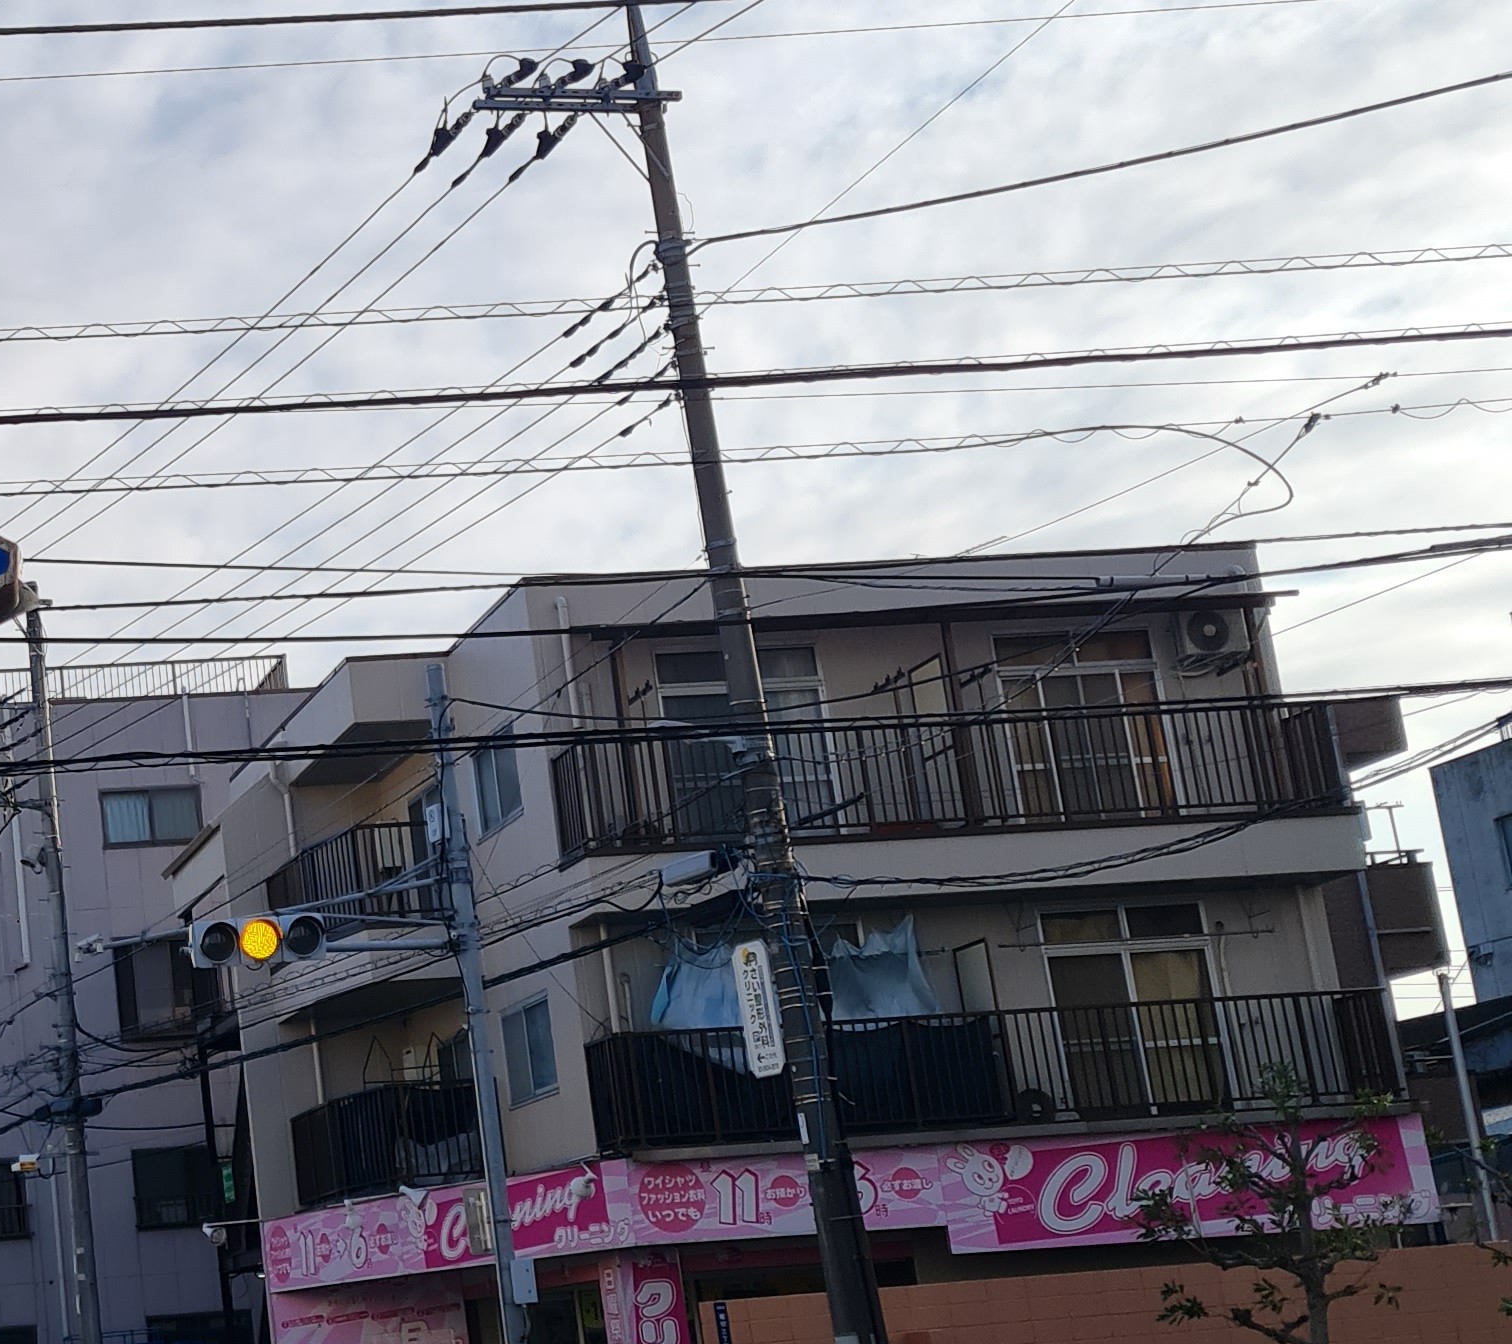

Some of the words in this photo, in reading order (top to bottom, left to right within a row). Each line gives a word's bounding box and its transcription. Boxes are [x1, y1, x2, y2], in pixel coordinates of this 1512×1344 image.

[644, 1175, 696, 1190] ワイシャツ
[647, 1207, 701, 1222] いつでも
[554, 1218, 630, 1249] クリーニング
